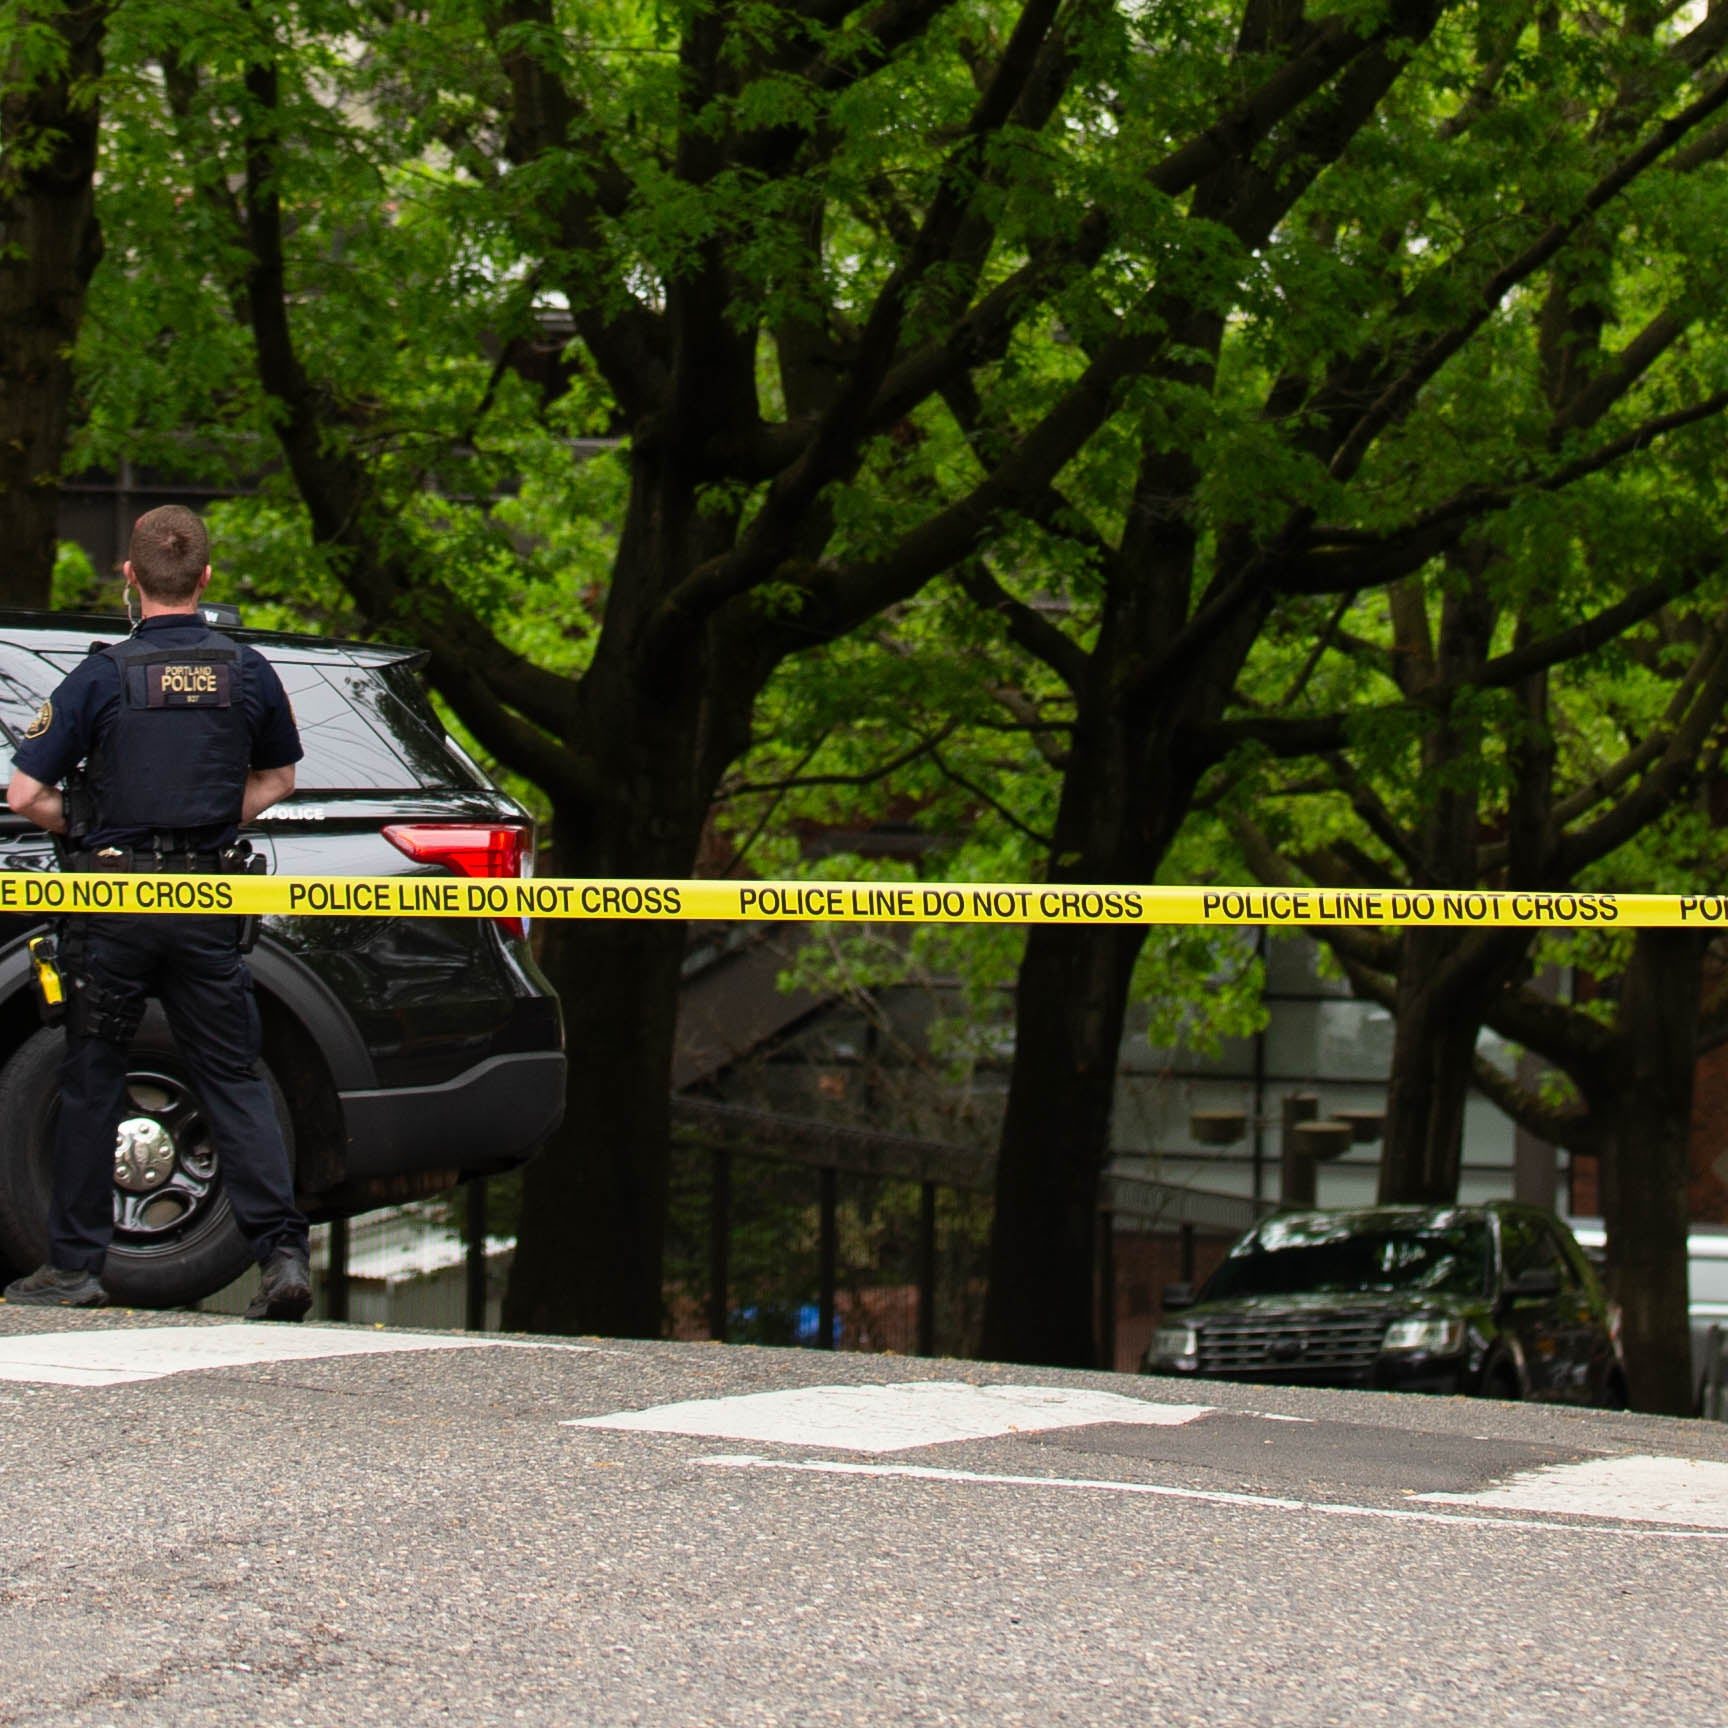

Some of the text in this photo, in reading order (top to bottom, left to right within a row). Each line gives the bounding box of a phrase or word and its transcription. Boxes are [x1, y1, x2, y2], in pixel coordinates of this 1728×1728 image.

[161, 675, 217, 692] POLICE
[164, 666, 212, 675] PORTLAND
[26, 880, 64, 906] DO
[73, 881, 128, 907] NOT
[136, 881, 232, 908] CROSS
[289, 883, 681, 914] POLICE LINE DO NOT CROSS
[741, 889, 1142, 918] POLICE LINE DO NOT CROSS
[1203, 893, 1618, 922] POLICE LINE DO NOT CROSS
